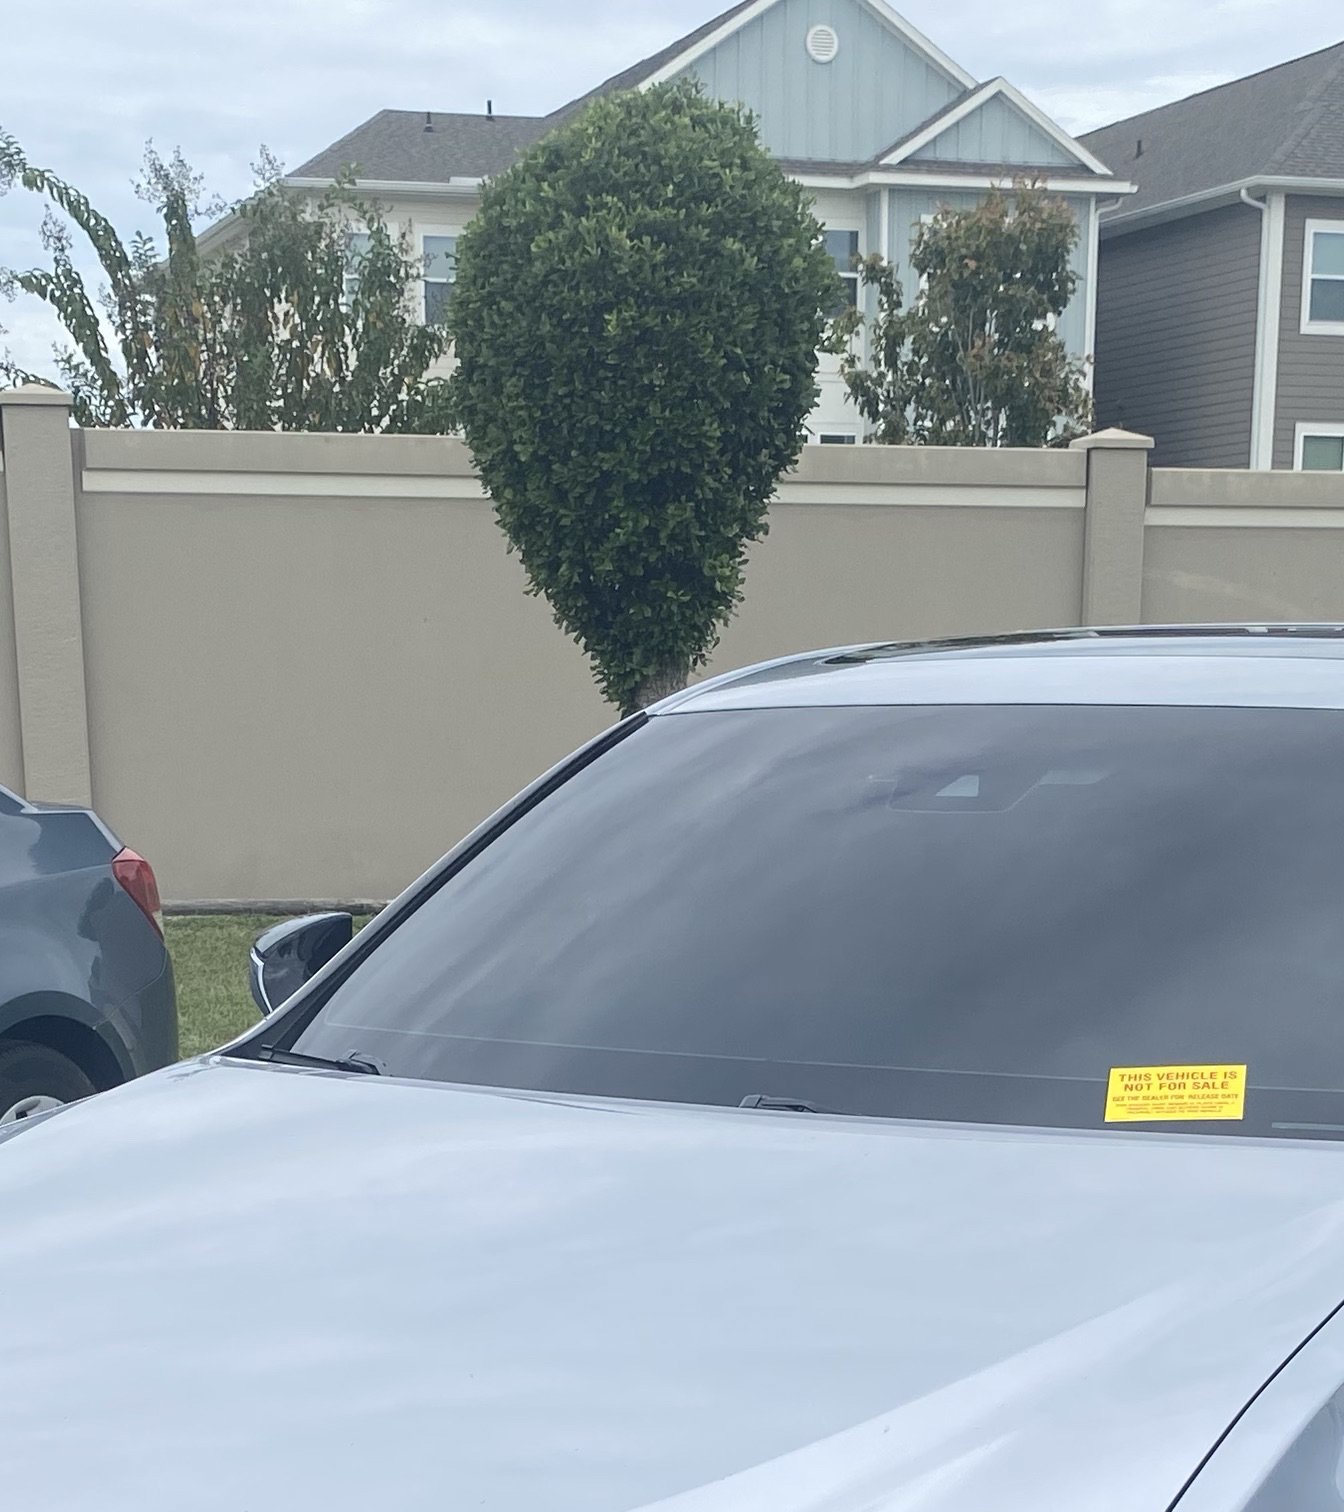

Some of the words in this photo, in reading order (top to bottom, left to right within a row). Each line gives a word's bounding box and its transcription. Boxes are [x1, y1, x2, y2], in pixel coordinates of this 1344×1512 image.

[1118, 1073, 1152, 1082] THIS
[1156, 1071, 1218, 1081] VEHICLE
[1223, 1070, 1238, 1080] IS
[1123, 1082, 1154, 1092] NOT
[1158, 1081, 1187, 1091] FOR
[1192, 1080, 1230, 1090] SALE
